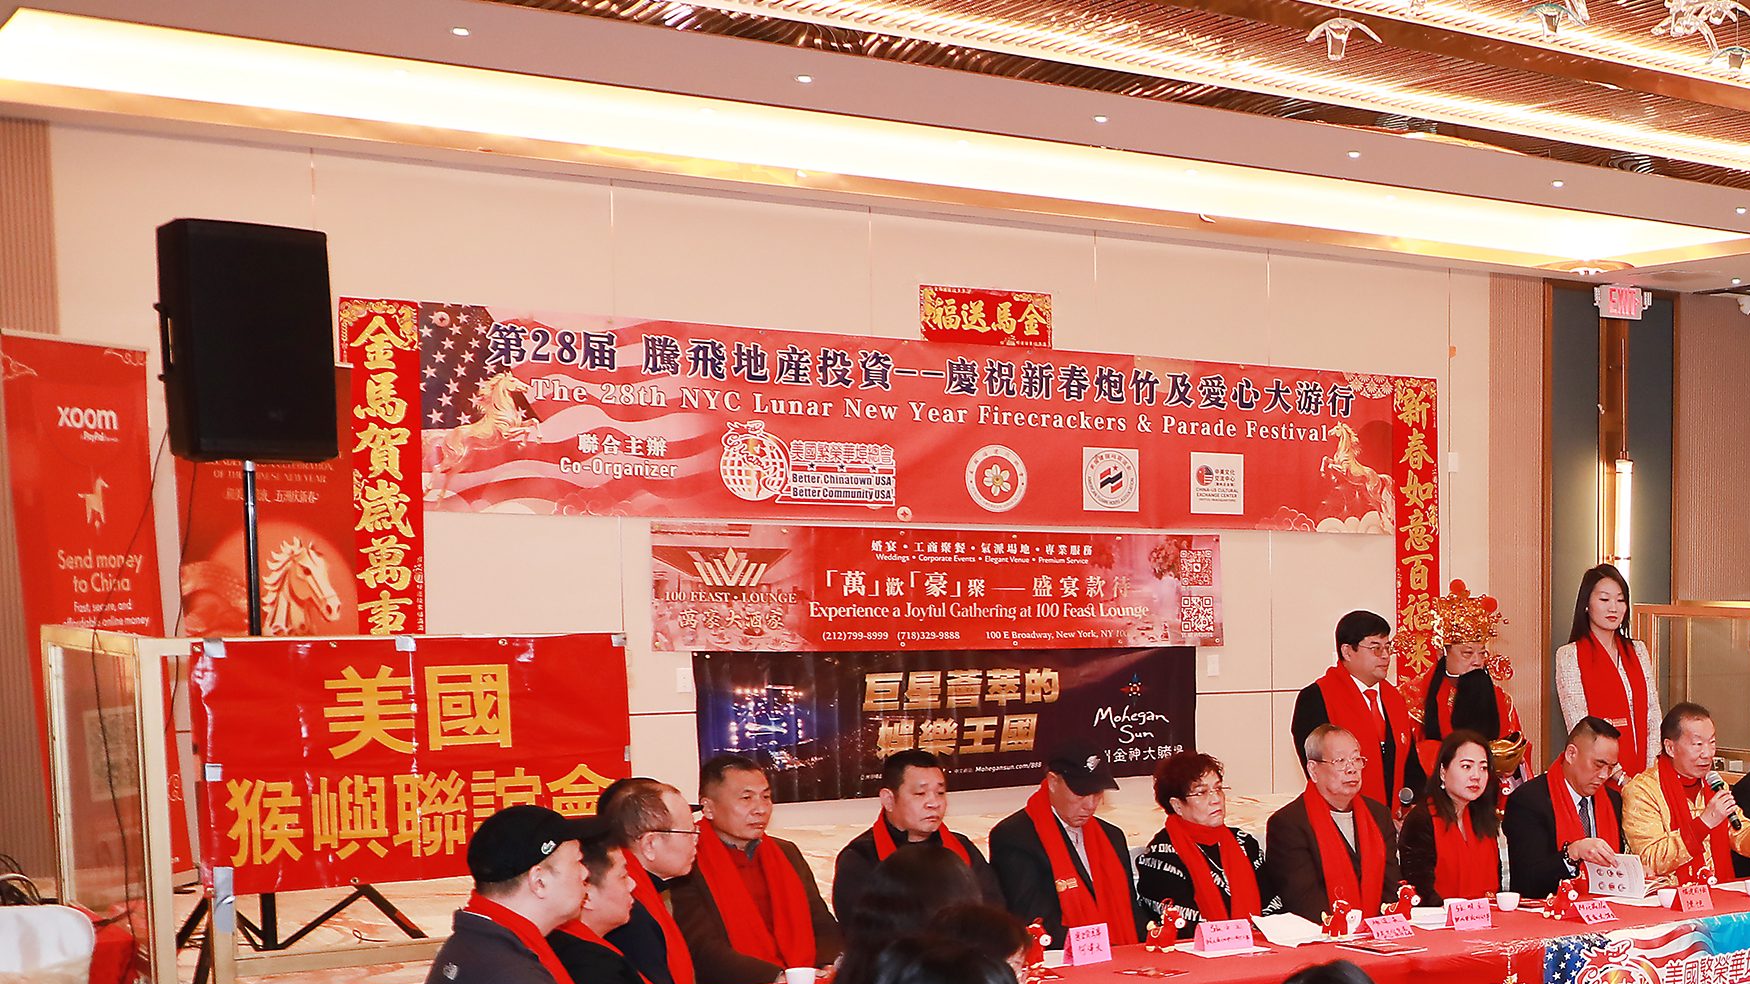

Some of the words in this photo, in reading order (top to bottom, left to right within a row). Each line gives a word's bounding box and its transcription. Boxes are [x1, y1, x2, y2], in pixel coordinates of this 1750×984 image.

[1609, 288, 1636, 317] EXIT
[57, 406, 118, 430] xoom
[531, 378, 587, 402] The
[600, 382, 668, 407] 28th
[680, 387, 741, 412] NYC
[753, 393, 833, 416] Lunar
[844, 398, 898, 420] New
[909, 401, 968, 424] Year
[978, 404, 1126, 432] Firecrackers
[1137, 414, 1152, 433] &
[1162, 416, 1237, 437] Parade
[1246, 420, 1328, 442] Festival
[790, 440, 894, 463] 美國繁榮華埠總會
[559, 459, 678, 480] Co-Organizer
[792, 473, 820, 486] Better
[822, 473, 873, 487] Chinatown
[875, 474, 893, 487] USA
[792, 486, 821, 499] Better
[822, 488, 873, 500] Community
[874, 489, 892, 500] USA
[57, 549, 92, 570] Send
[96, 551, 142, 573] money
[876, 553, 910, 562] Weddings
[918, 554, 952, 563] Corporate
[984, 555, 1009, 565] Elegant
[1010, 556, 1030, 564] Venue
[1038, 556, 1066, 564] Premium
[1067, 557, 1089, 565] Service
[73, 575, 88, 592] to
[90, 572, 130, 592] China
[665, 591, 686, 602] 100
[690, 591, 730, 603] FEAST
[741, 592, 797, 604] LOUNGE
[809, 601, 889, 621] Experience
[892, 606, 900, 618] a
[904, 602, 946, 621] Joyful
[950, 602, 1016, 621] Gathering
[1020, 605, 1032, 617] at
[1036, 603, 1059, 617] 100
[1063, 603, 1095, 618] Feast
[1099, 603, 1150, 621] Lounge
[124, 616, 150, 627] money
[822, 631, 889, 641] (212)799-8999
[897, 631, 960, 641] (718)329-9888
[986, 631, 1002, 639] 100
[1003, 631, 1010, 639] E
[1011, 631, 1055, 641] Broadway,
[1056, 631, 1076, 639] New
[1077, 630, 1099, 640] York,
[1101, 630, 1114, 638] NY
[862, 667, 1061, 712] 巨星薈萃的
[323, 662, 513, 760] 美國
[1093, 705, 1170, 728] Mohegan
[1118, 724, 1154, 744] Sun
[975, 761, 1042, 773] Mohegansun.com/888
